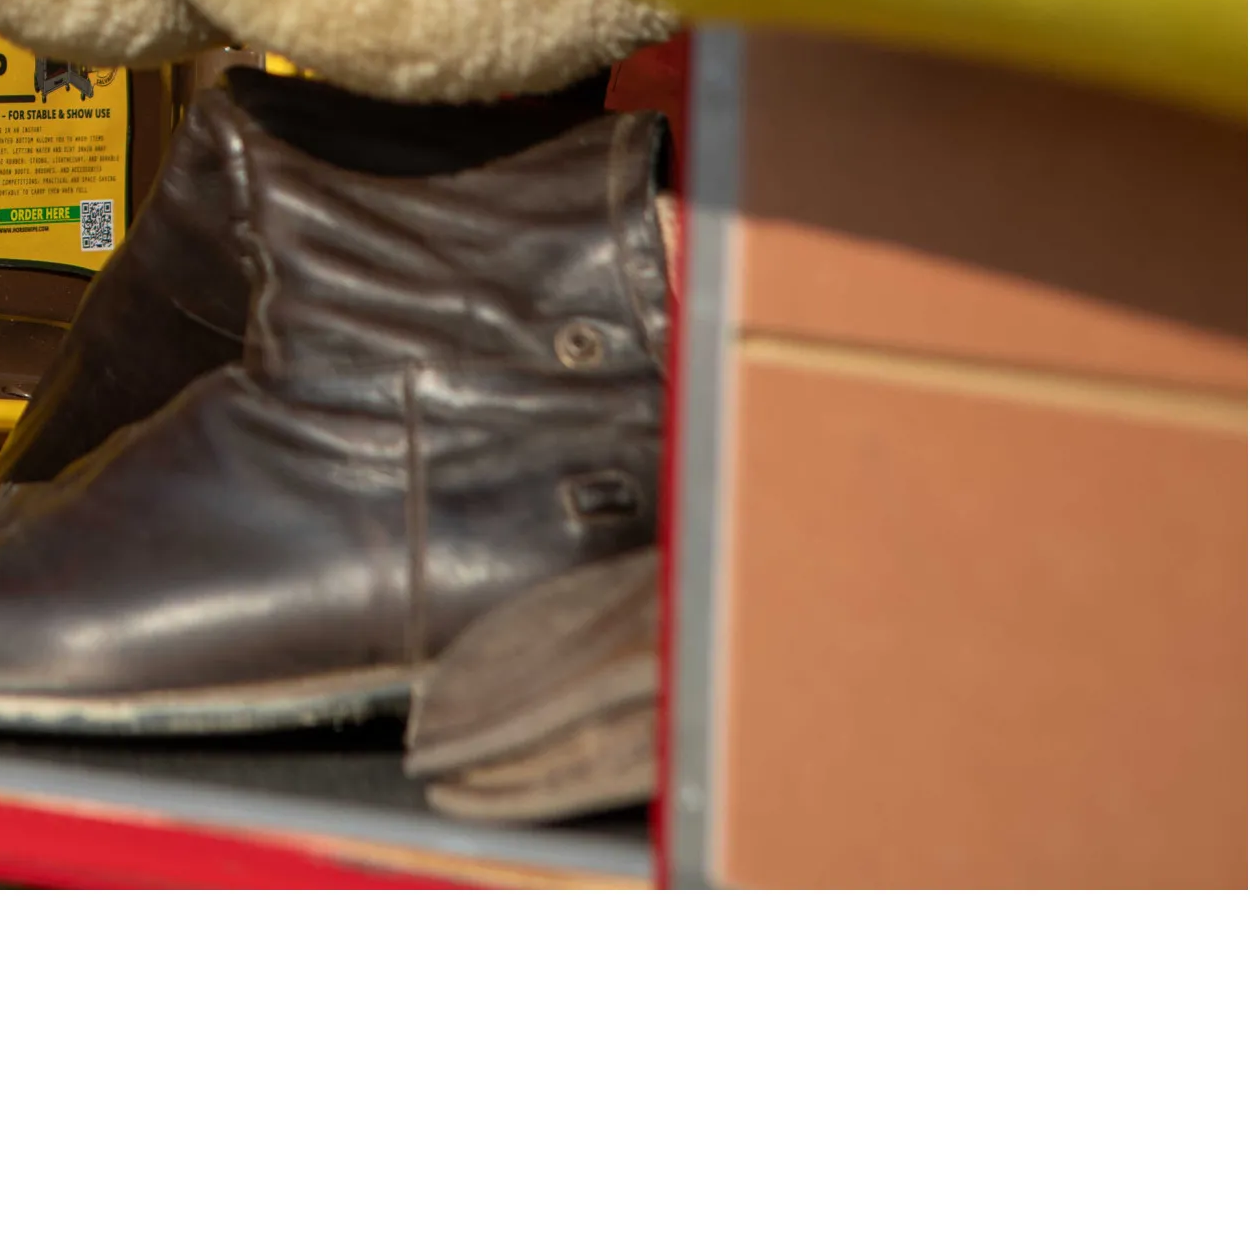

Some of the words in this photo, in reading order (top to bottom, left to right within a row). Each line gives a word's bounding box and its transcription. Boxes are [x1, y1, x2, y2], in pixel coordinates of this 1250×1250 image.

[9, 110, 24, 120] FOR
[27, 110, 56, 119] STABLE
[59, 109, 64, 119] &
[67, 109, 92, 119] SHOW
[96, 109, 110, 118] USE
[11, 208, 43, 221] ORDER
[46, 207, 70, 219] HERE
